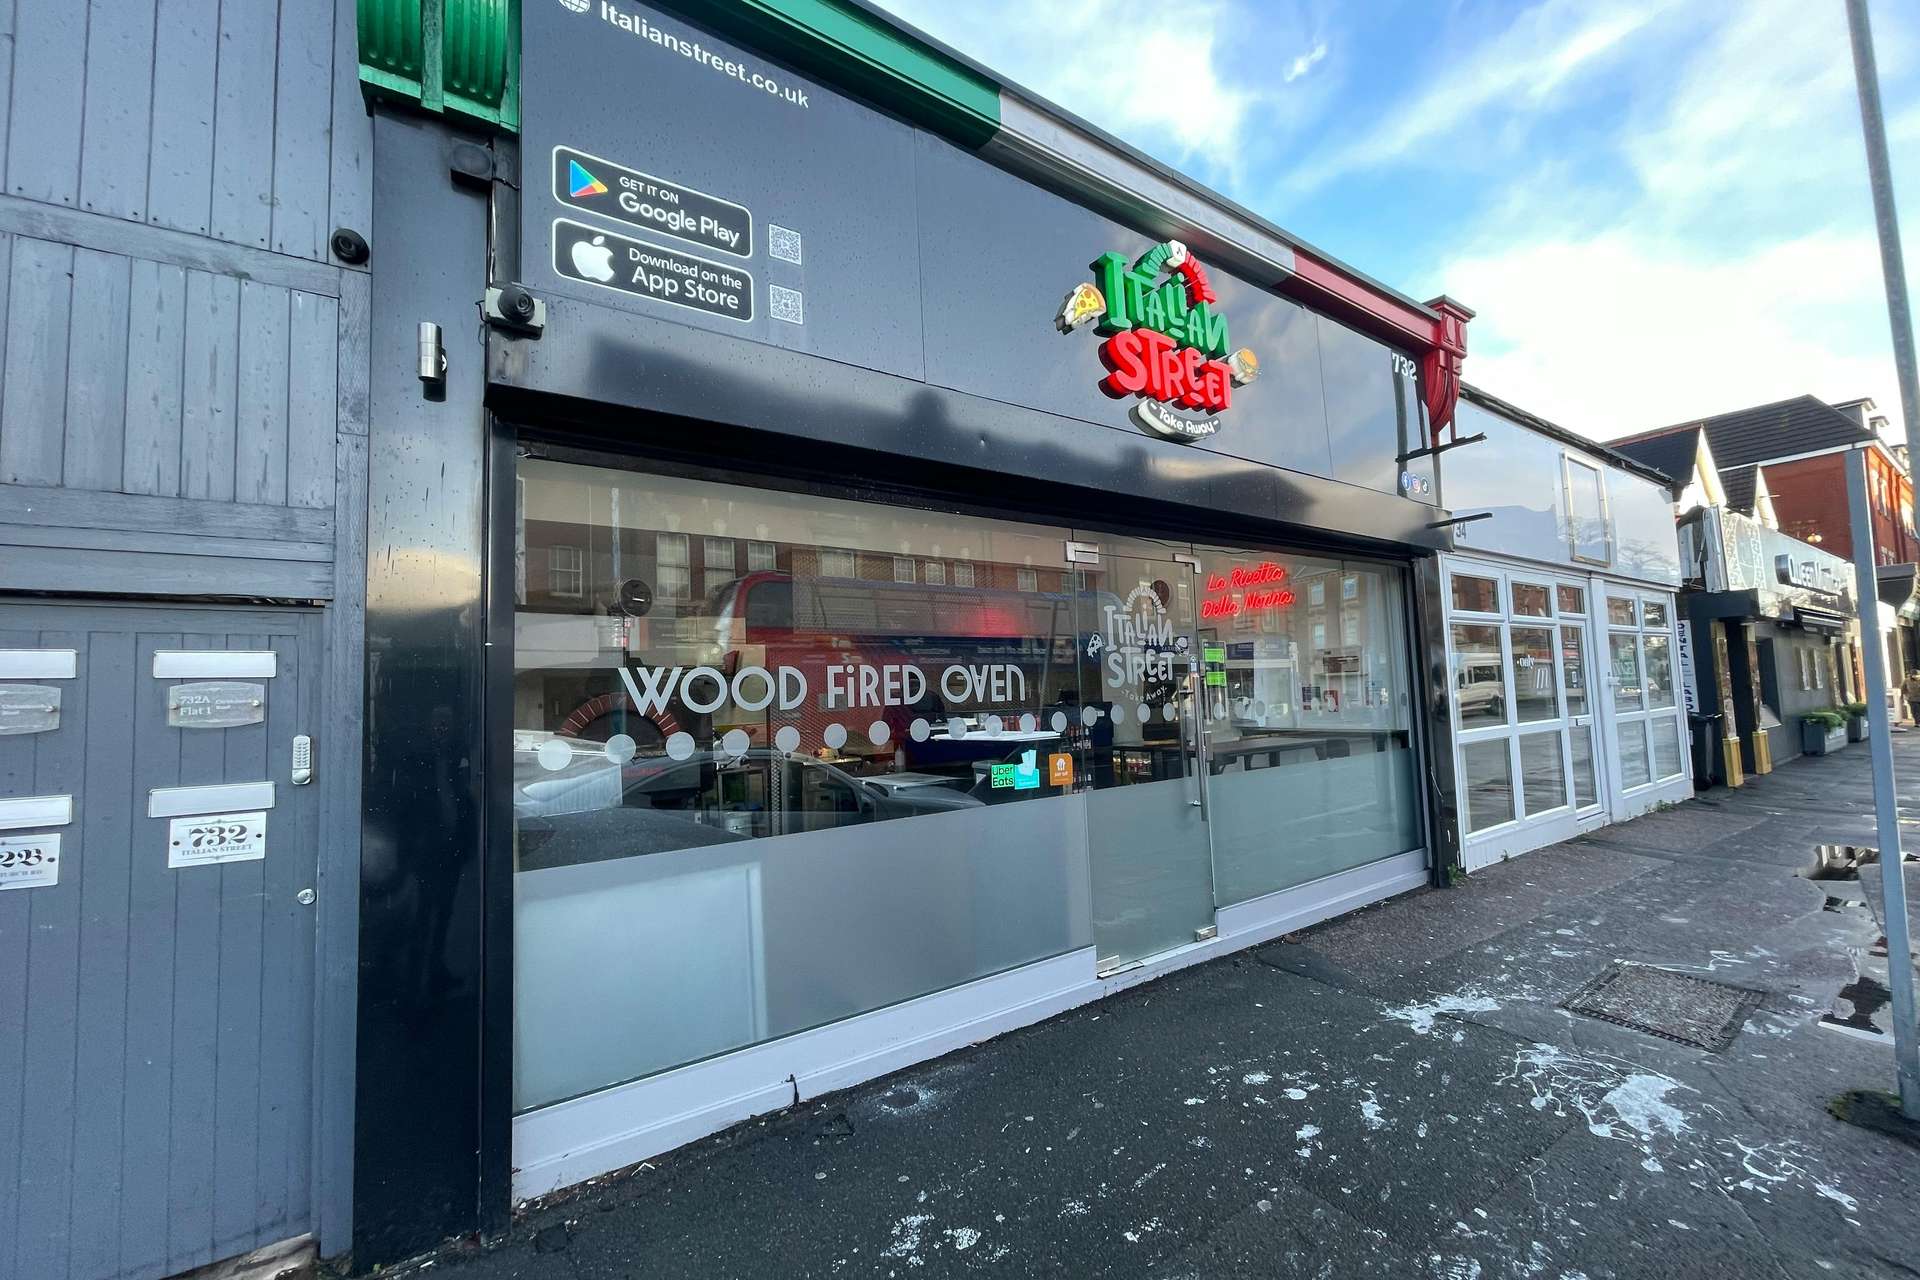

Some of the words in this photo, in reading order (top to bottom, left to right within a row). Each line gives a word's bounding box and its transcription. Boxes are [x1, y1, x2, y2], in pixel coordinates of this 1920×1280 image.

[601, 1, 809, 108] Italianstreet.co.uk
[619, 176, 644, 193] GET
[647, 184, 657, 197] IT
[660, 189, 679, 204] ON
[619, 192, 696, 231] Google
[700, 215, 740, 247] Play
[629, 247, 698, 278] Download
[701, 270, 719, 283] on
[721, 274, 742, 290] the
[632, 266, 679, 296] App
[685, 280, 739, 309] Store
[1391, 352, 1418, 381] 732
[1159, 406, 1184, 430] Take
[1186, 420, 1215, 433] Away
[1207, 573, 1227, 591] La
[1202, 594, 1241, 618] Della
[617, 664, 808, 717] WOOD
[180, 706, 204, 716] Flat
[993, 765, 1013, 776] Uber
[993, 777, 1014, 787] Eats
[190, 824, 248, 848] 732
[182, 847, 219, 857] ITALIAN
[220, 843, 253, 853] STREET
